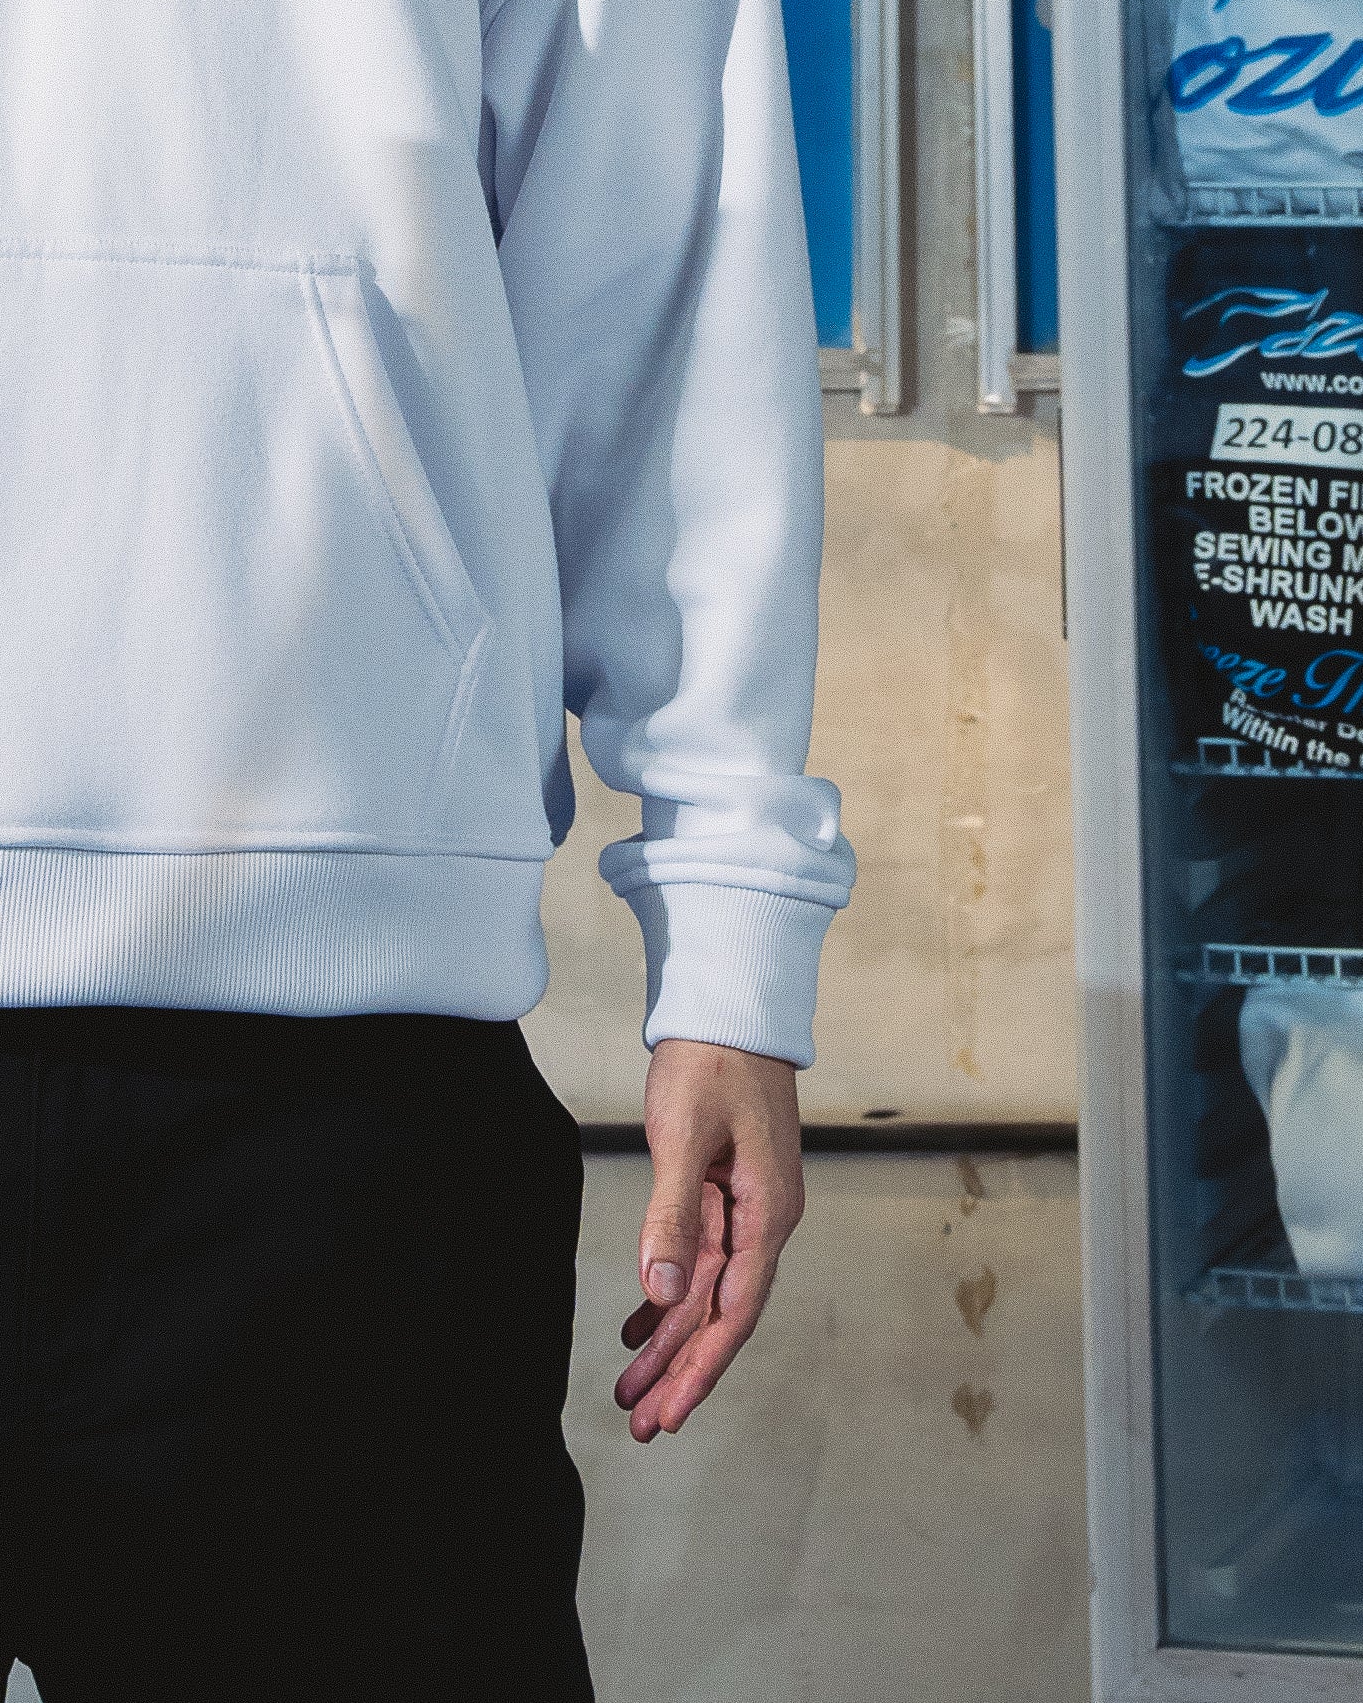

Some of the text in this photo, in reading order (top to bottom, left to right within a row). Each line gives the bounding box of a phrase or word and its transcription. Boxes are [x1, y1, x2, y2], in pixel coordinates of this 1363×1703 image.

[1223, 417, 1363, 455] 224-08
[1186, 470, 1363, 511] FROZEN FI
[1192, 530, 1333, 571] SEWING
[1248, 598, 1354, 637] WASH
[1222, 701, 1300, 756] Within
[1305, 737, 1351, 768] the
